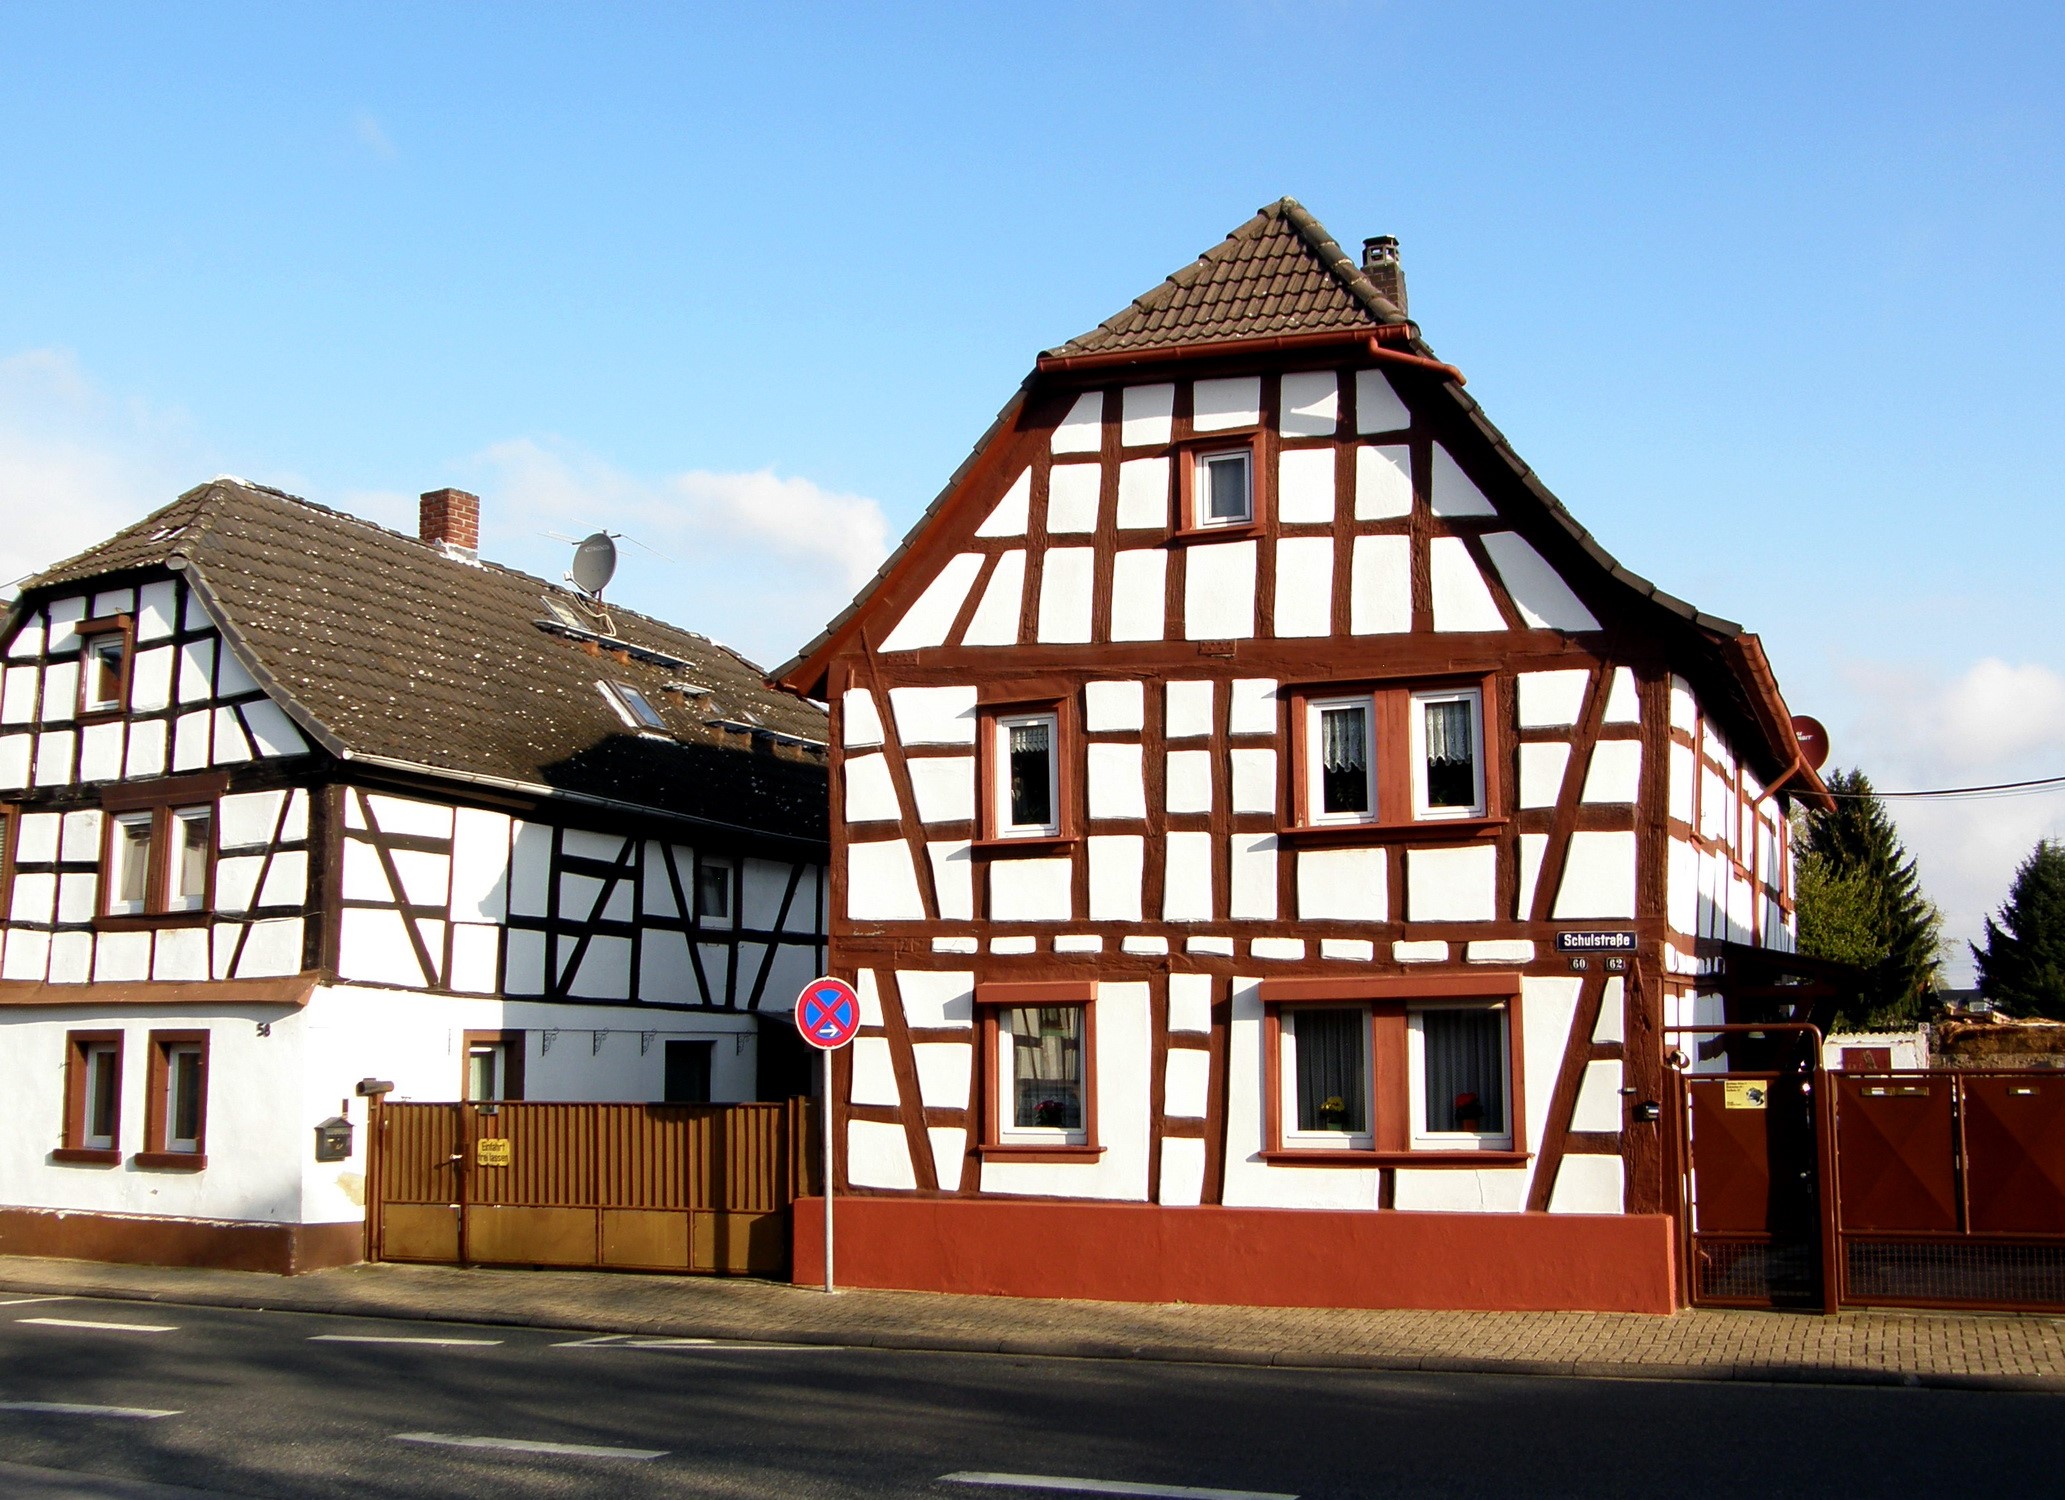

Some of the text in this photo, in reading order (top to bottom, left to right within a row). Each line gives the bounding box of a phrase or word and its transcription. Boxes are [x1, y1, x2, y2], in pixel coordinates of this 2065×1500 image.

[1564, 933, 1630, 947] Schulstraße
[1572, 958, 1586, 969] 60
[1609, 958, 1623, 969] 62
[256, 1022, 271, 1037] 58
